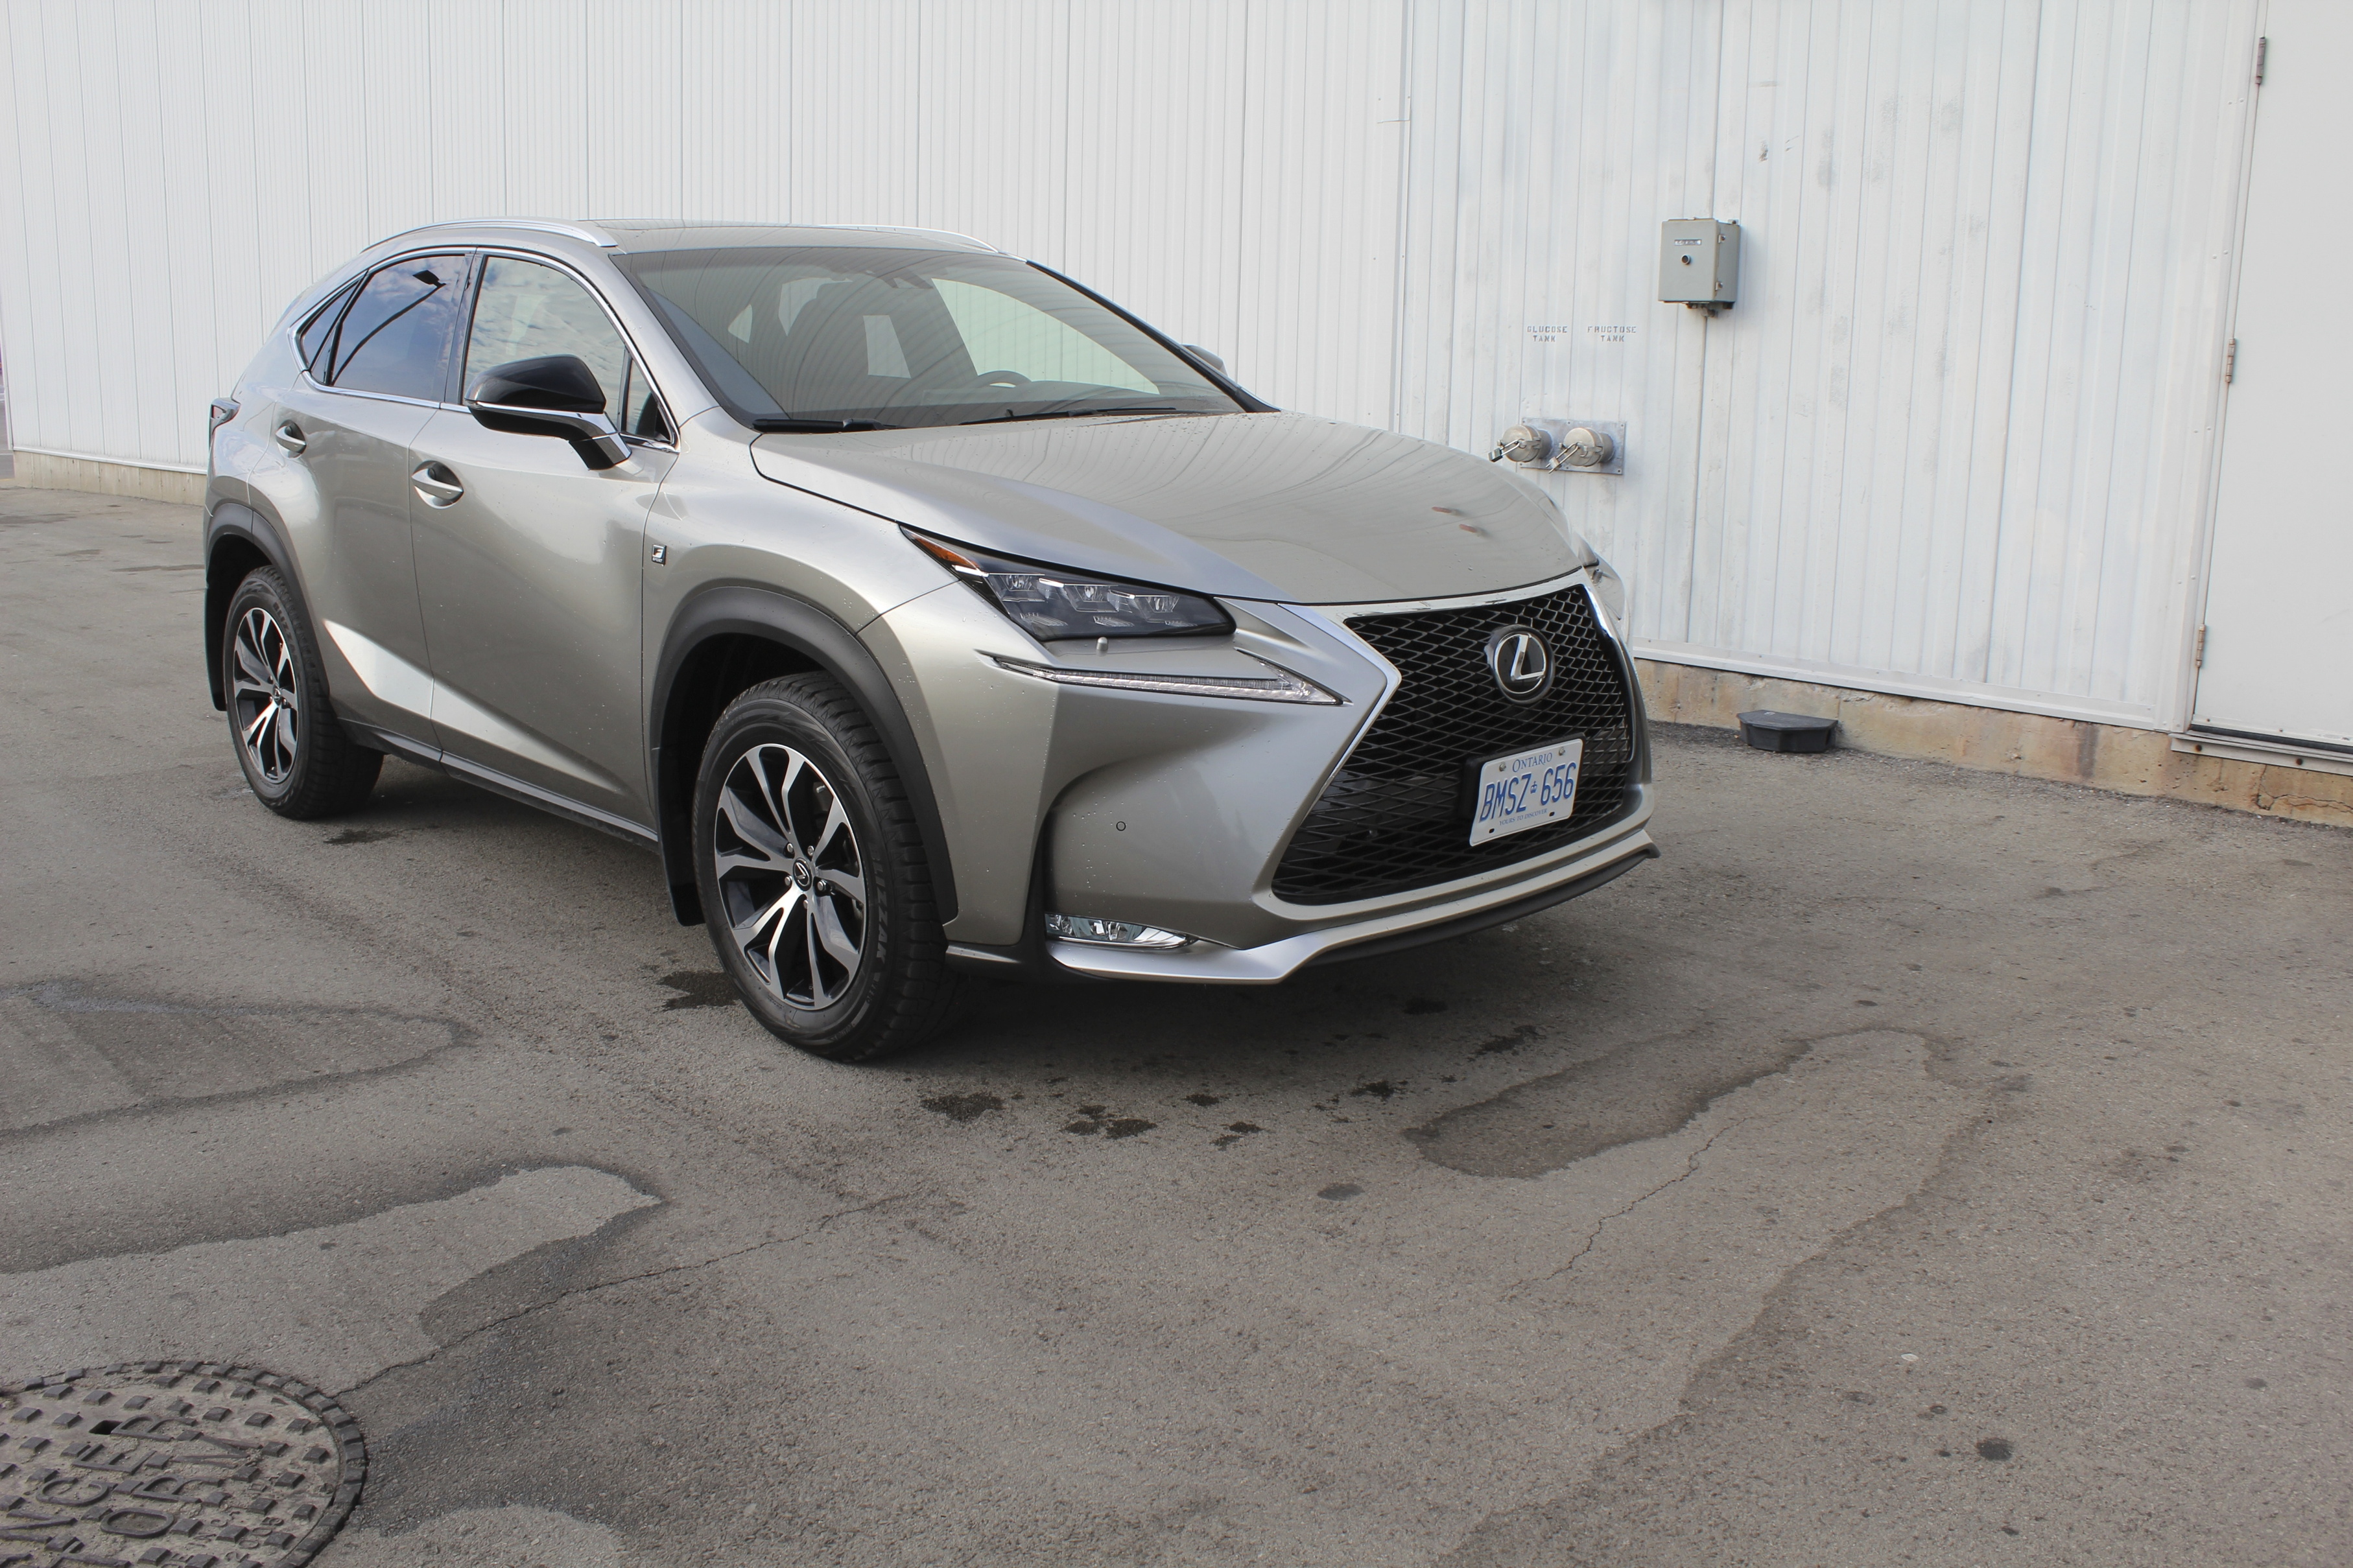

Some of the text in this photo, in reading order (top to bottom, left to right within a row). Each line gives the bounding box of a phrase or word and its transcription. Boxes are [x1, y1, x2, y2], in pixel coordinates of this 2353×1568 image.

[1479, 762, 1577, 823] BMSZ 656
[1512, 753, 1553, 772] ONTARIO
[1499, 817, 1515, 825] YOURS
[1524, 808, 1548, 819] DISCOVER
[869, 842, 888, 964] BLIZZAK
[44, 1435, 263, 1568] TORM
